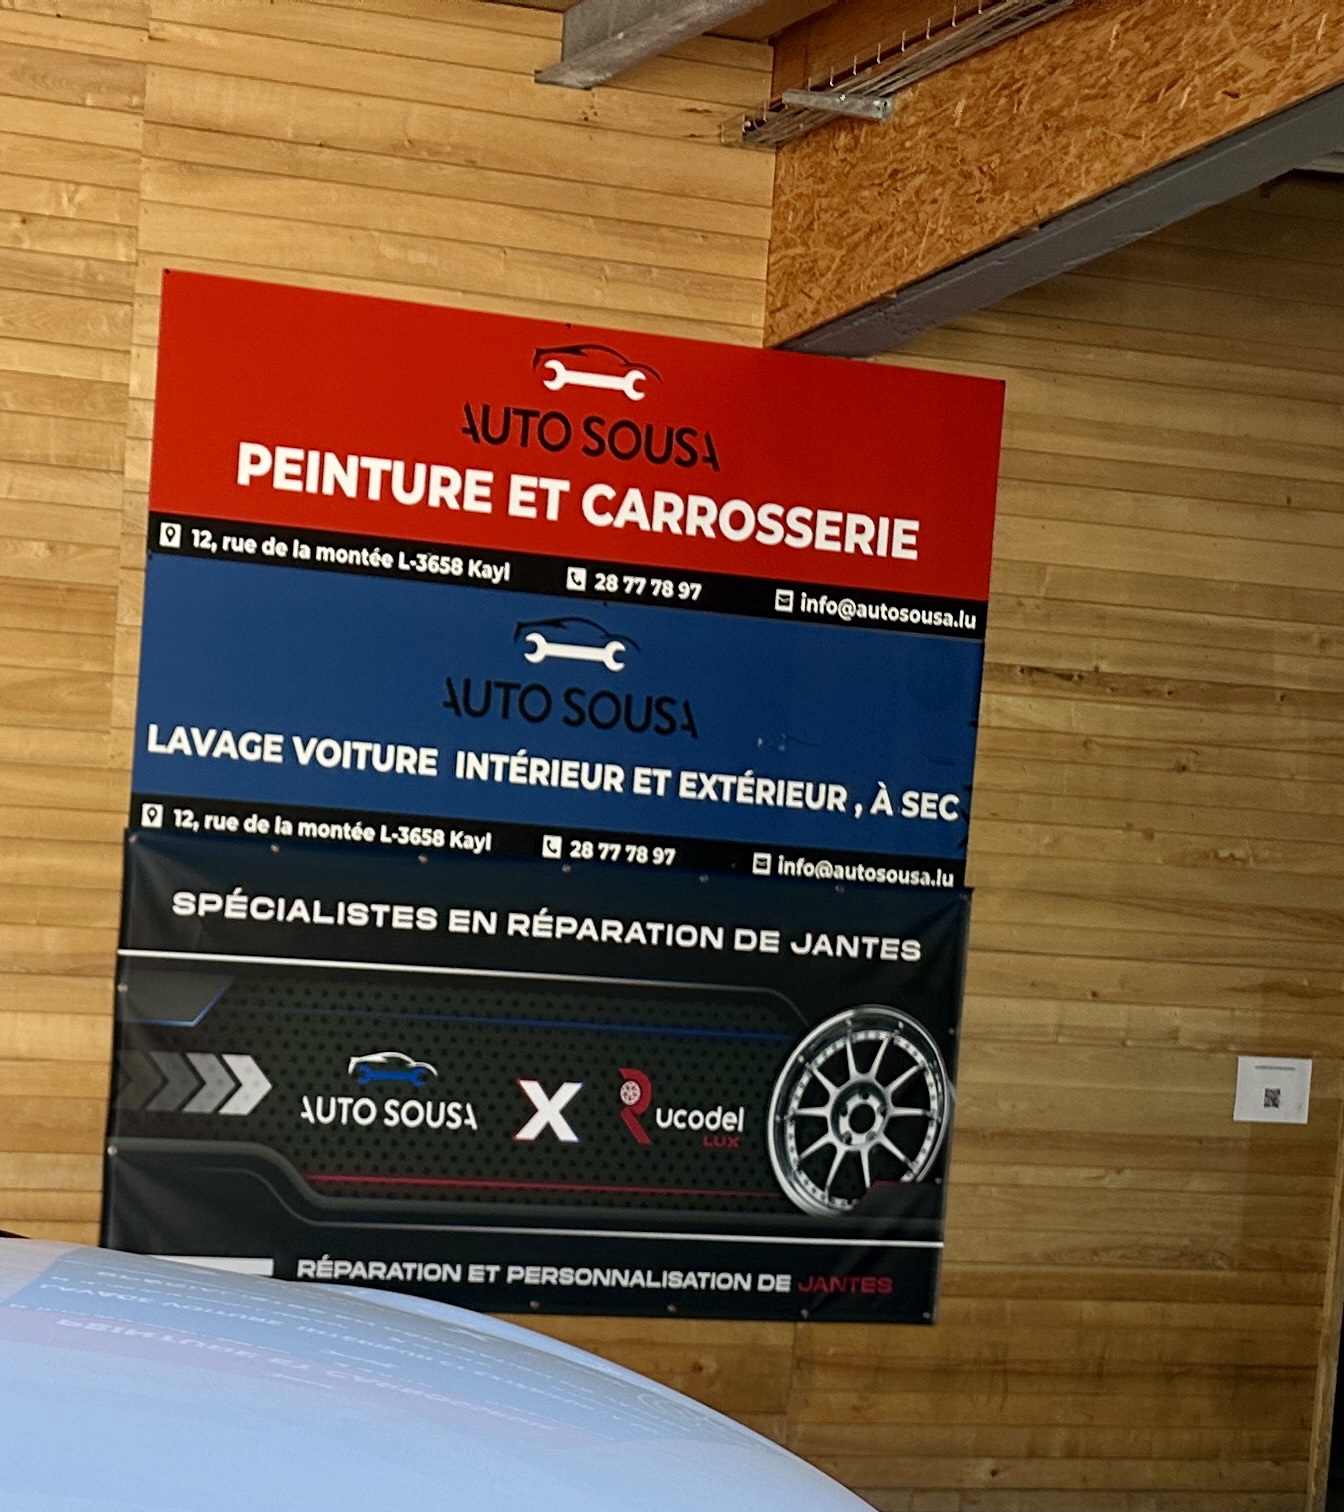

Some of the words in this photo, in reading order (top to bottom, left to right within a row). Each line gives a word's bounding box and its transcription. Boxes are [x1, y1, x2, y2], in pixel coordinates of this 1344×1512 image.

[461, 401, 572, 452] AUTO
[582, 414, 721, 472] SOUSA
[237, 441, 494, 514] PEINTURE
[508, 473, 570, 521] ET
[582, 482, 920, 561] CARROSSERIE
[191, 528, 218, 553] 12,
[222, 535, 257, 554] rue
[261, 536, 288, 558] de
[293, 539, 311, 561] la
[315, 544, 394, 568] montée
[398, 551, 463, 576] L-3658
[468, 559, 511, 583] Kayl
[594, 572, 618, 592] 28
[622, 574, 646, 595] 77
[650, 577, 674, 598] 78
[678, 580, 702, 600] 97
[800, 591, 977, 631] info@autosousa.lu
[442, 676, 551, 723] AUTO
[562, 686, 699, 739] SOUSA
[147, 723, 285, 765] LAVAGE
[291, 735, 439, 777] VOITURE
[454, 748, 625, 793] INTÉRIEUR
[633, 767, 673, 797] ET
[678, 769, 848, 813] EXTÉRIEUR
[870, 781, 894, 817] À
[900, 792, 961, 822] SEC
[173, 807, 199, 832] 12,
[203, 811, 240, 833] rue
[243, 812, 269, 835] de
[274, 815, 293, 838] la
[298, 820, 375, 843] montée
[380, 824, 445, 847] L-3658
[449, 830, 493, 856] Kayl
[569, 839, 593, 859] 28
[598, 842, 621, 861] 77
[625, 844, 648, 864] 78
[652, 847, 676, 866] 97
[777, 854, 955, 889] info@autosousa.lu
[172, 886, 438, 931] SPÉCIALISTES
[448, 908, 497, 936] EN
[507, 907, 724, 951] RÉPARATION
[734, 928, 780, 954] DE
[790, 931, 921, 961] JANTES
[300, 1095, 378, 1127] AUTO
[382, 1097, 478, 1131] SOUSA
[703, 1135, 741, 1148] LUX
[296, 1254, 462, 1283] RÉPARATION
[468, 1264, 500, 1283] ET
[506, 1264, 751, 1291] PERSONNALISATION
[757, 1273, 792, 1293] DE
[797, 1275, 893, 1294] JANTES
